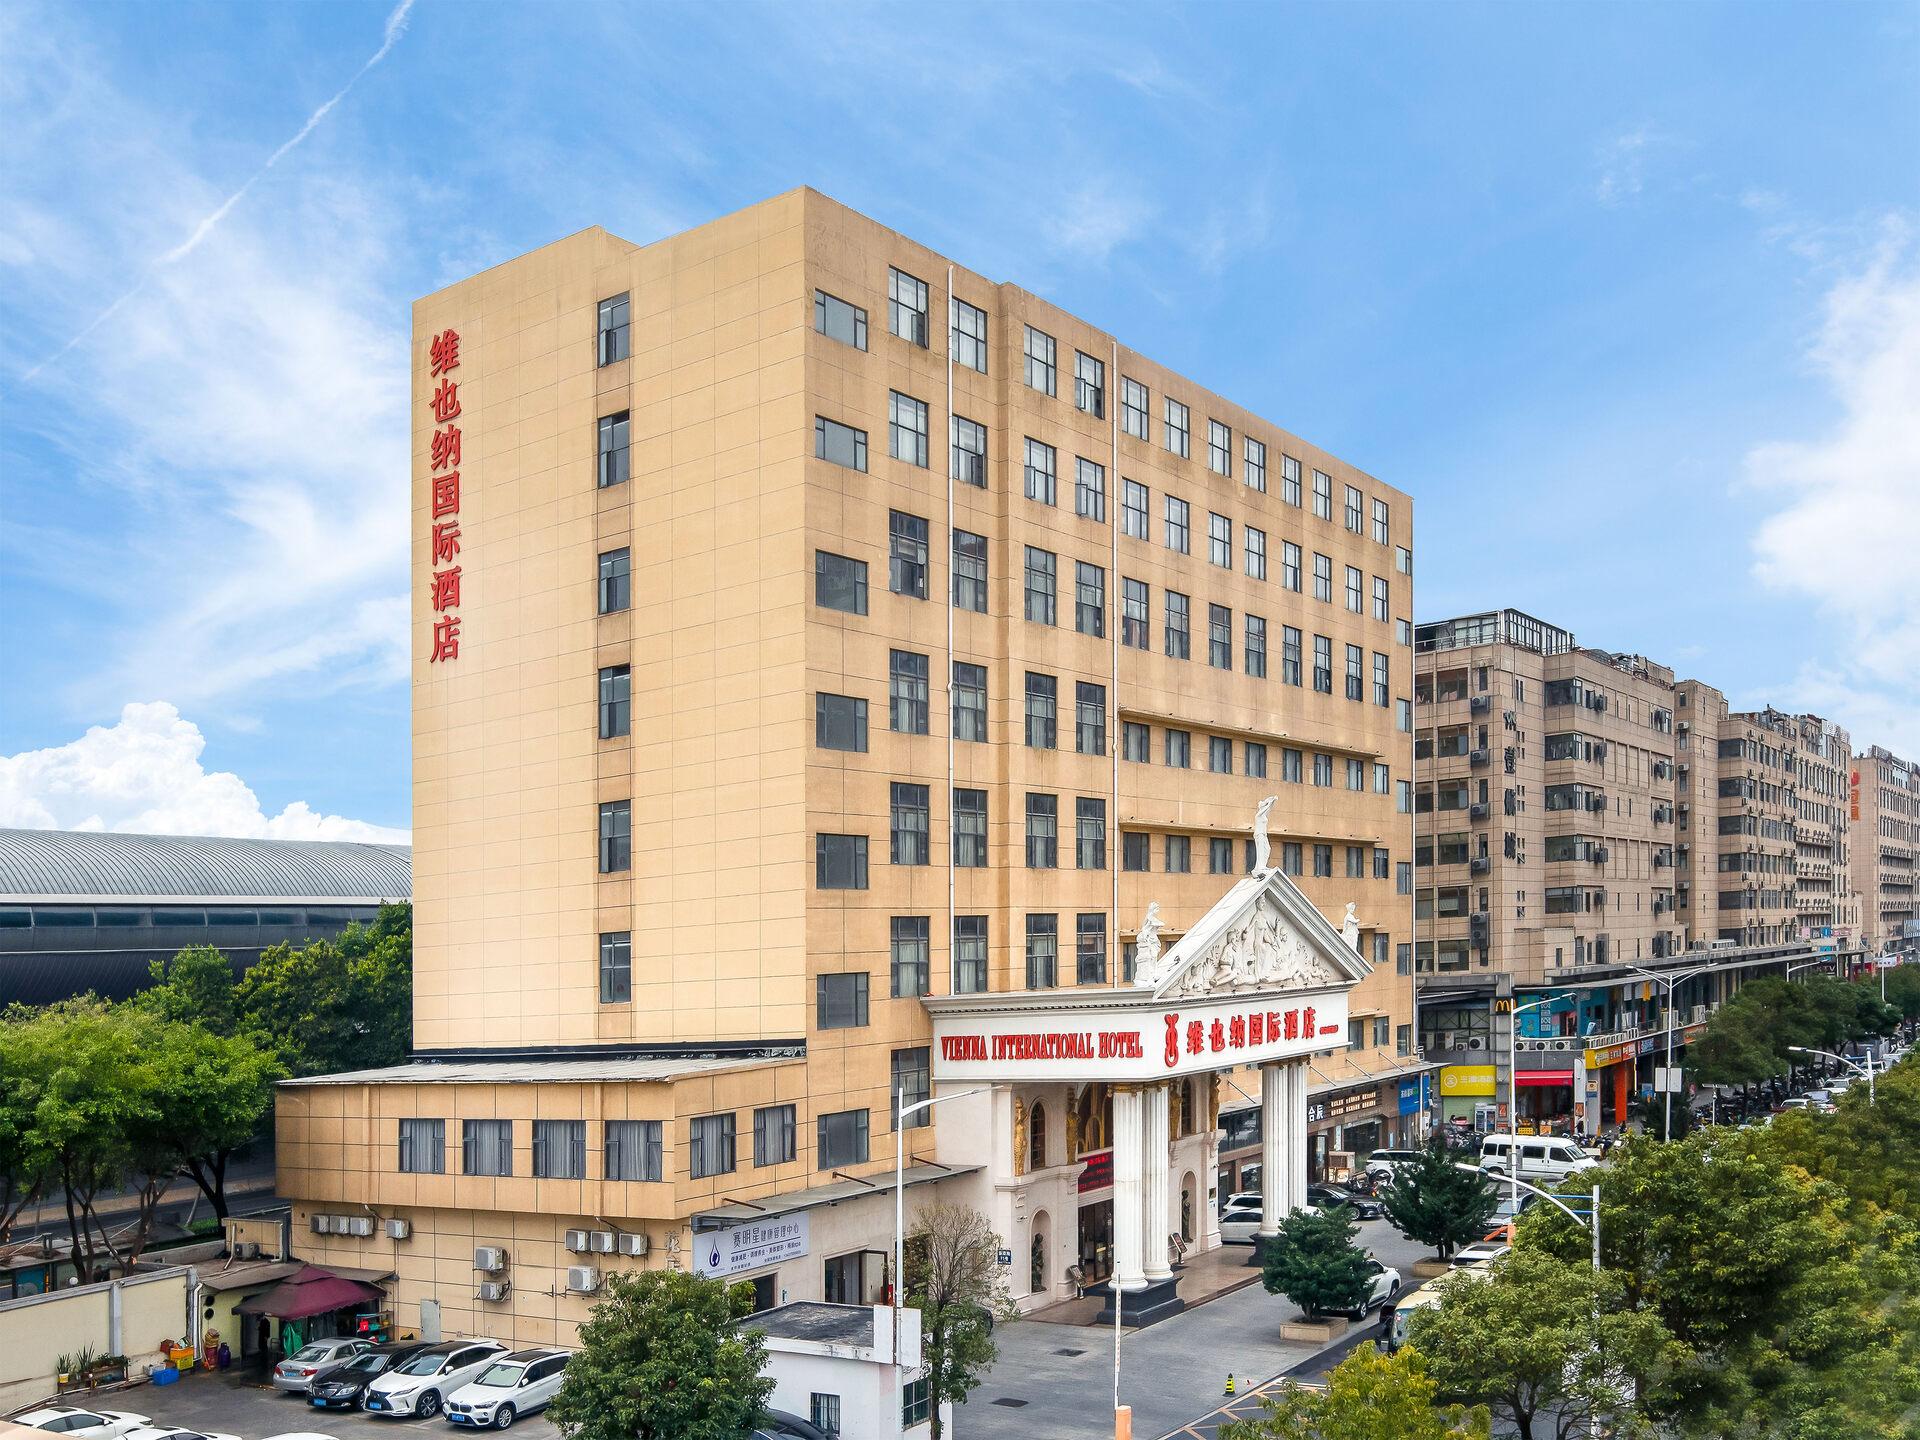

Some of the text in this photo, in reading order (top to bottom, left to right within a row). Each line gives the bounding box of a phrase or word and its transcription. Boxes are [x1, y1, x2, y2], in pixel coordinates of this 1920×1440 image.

[430, 329, 462, 663] 维也纳国际酒店
[941, 1031, 1144, 1061] VIENNA INTERNATIONAL HOTEL
[1186, 1007, 1316, 1055] 维也纳国际酒店
[732, 1222, 800, 1249] 赛明星健康管理中心
